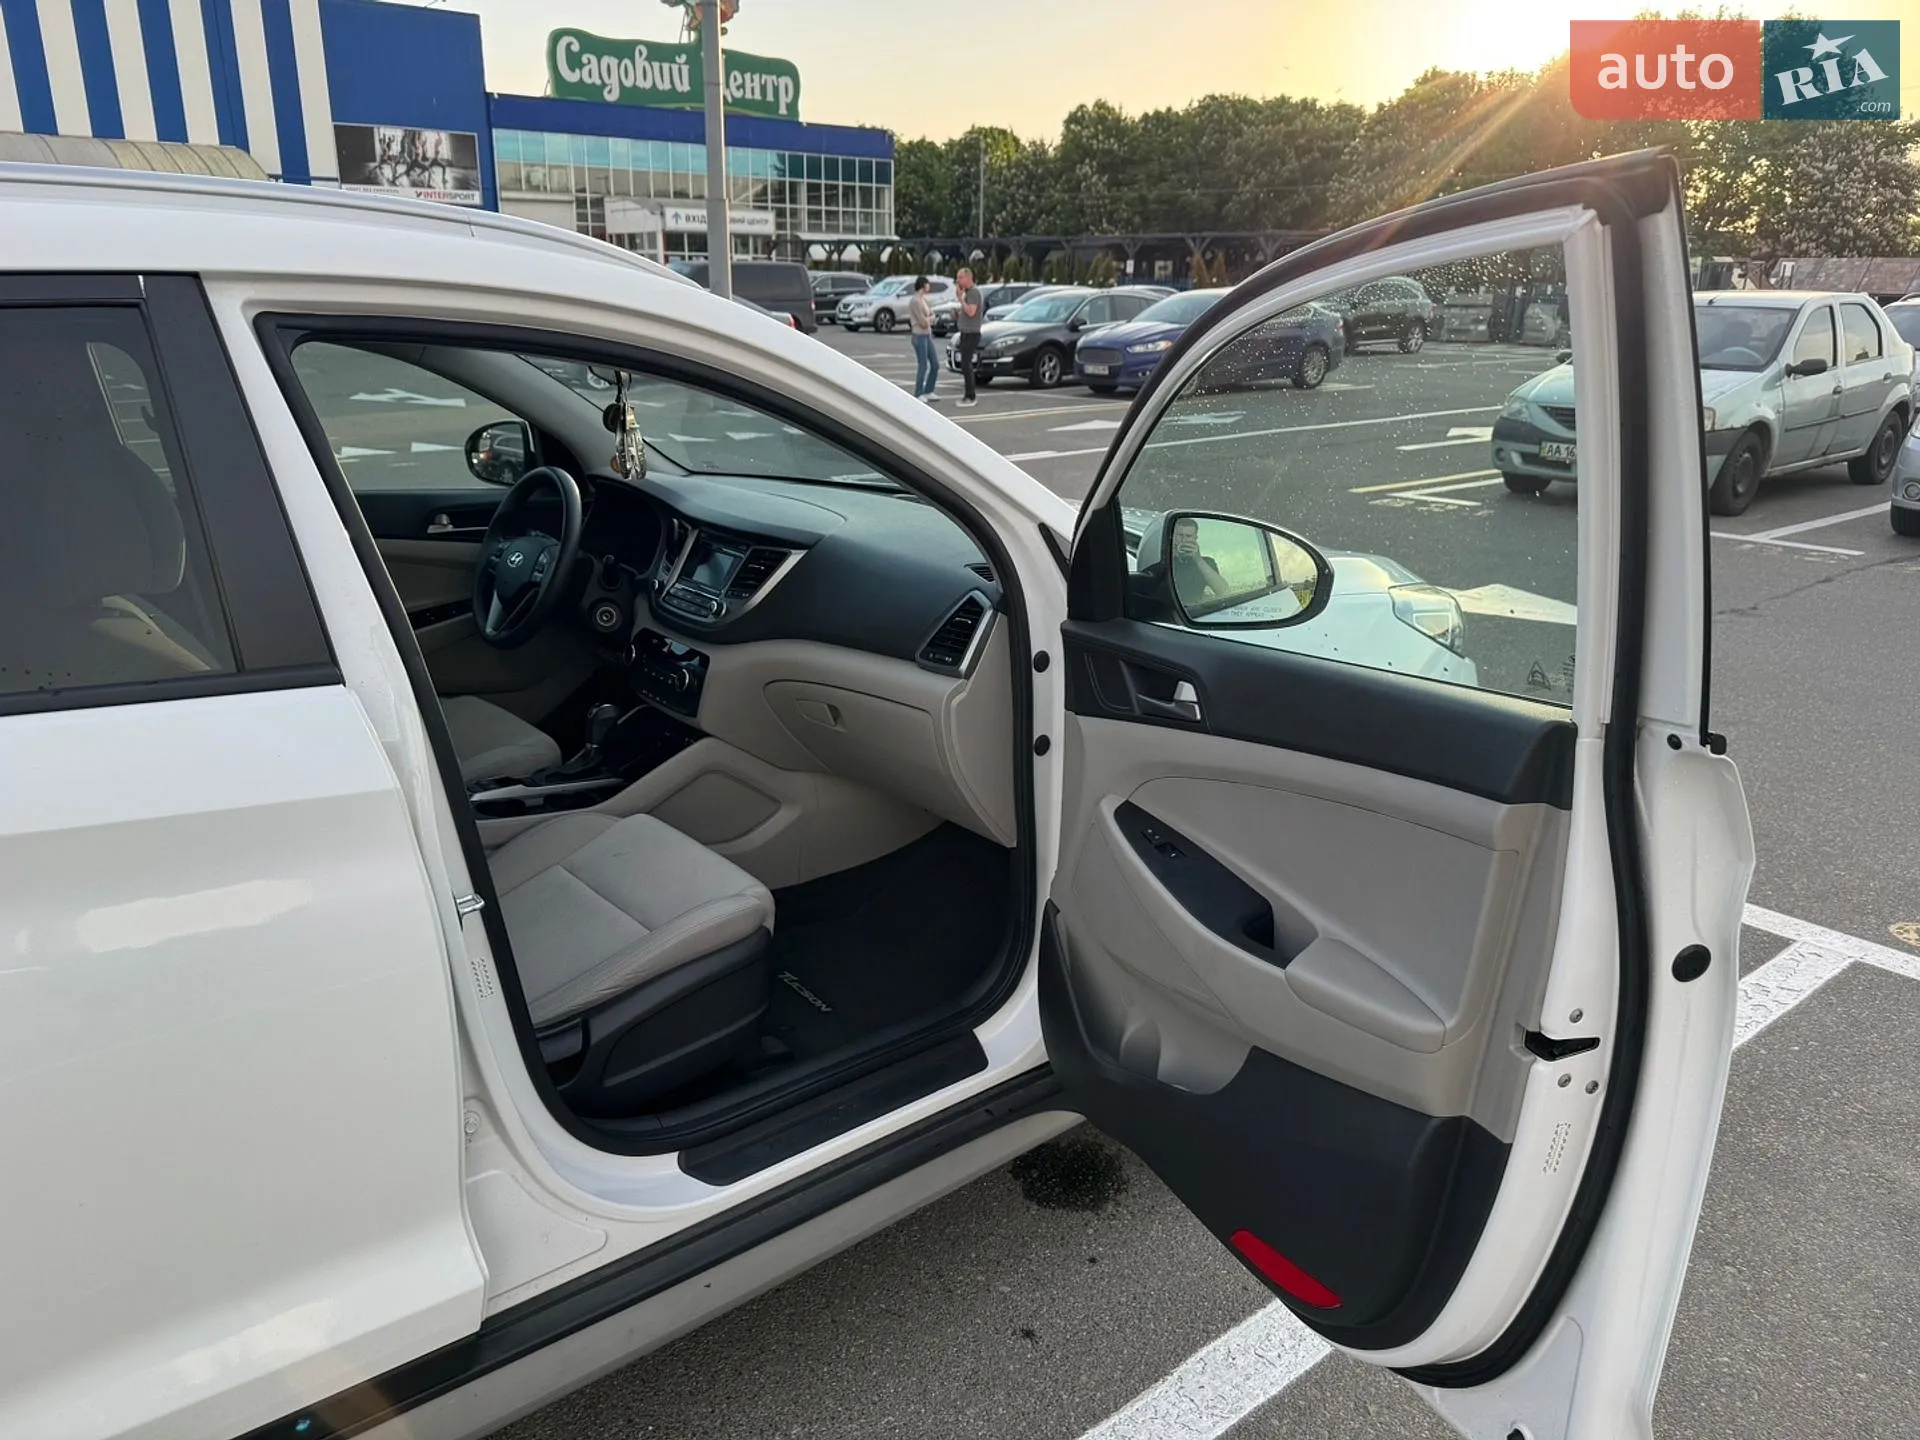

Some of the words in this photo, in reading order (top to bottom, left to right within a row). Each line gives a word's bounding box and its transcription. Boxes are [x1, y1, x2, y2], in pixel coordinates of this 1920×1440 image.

[556, 35, 692, 102] Садовий
[722, 55, 795, 116] ентр
[423, 190, 476, 201] INTERSPORT
